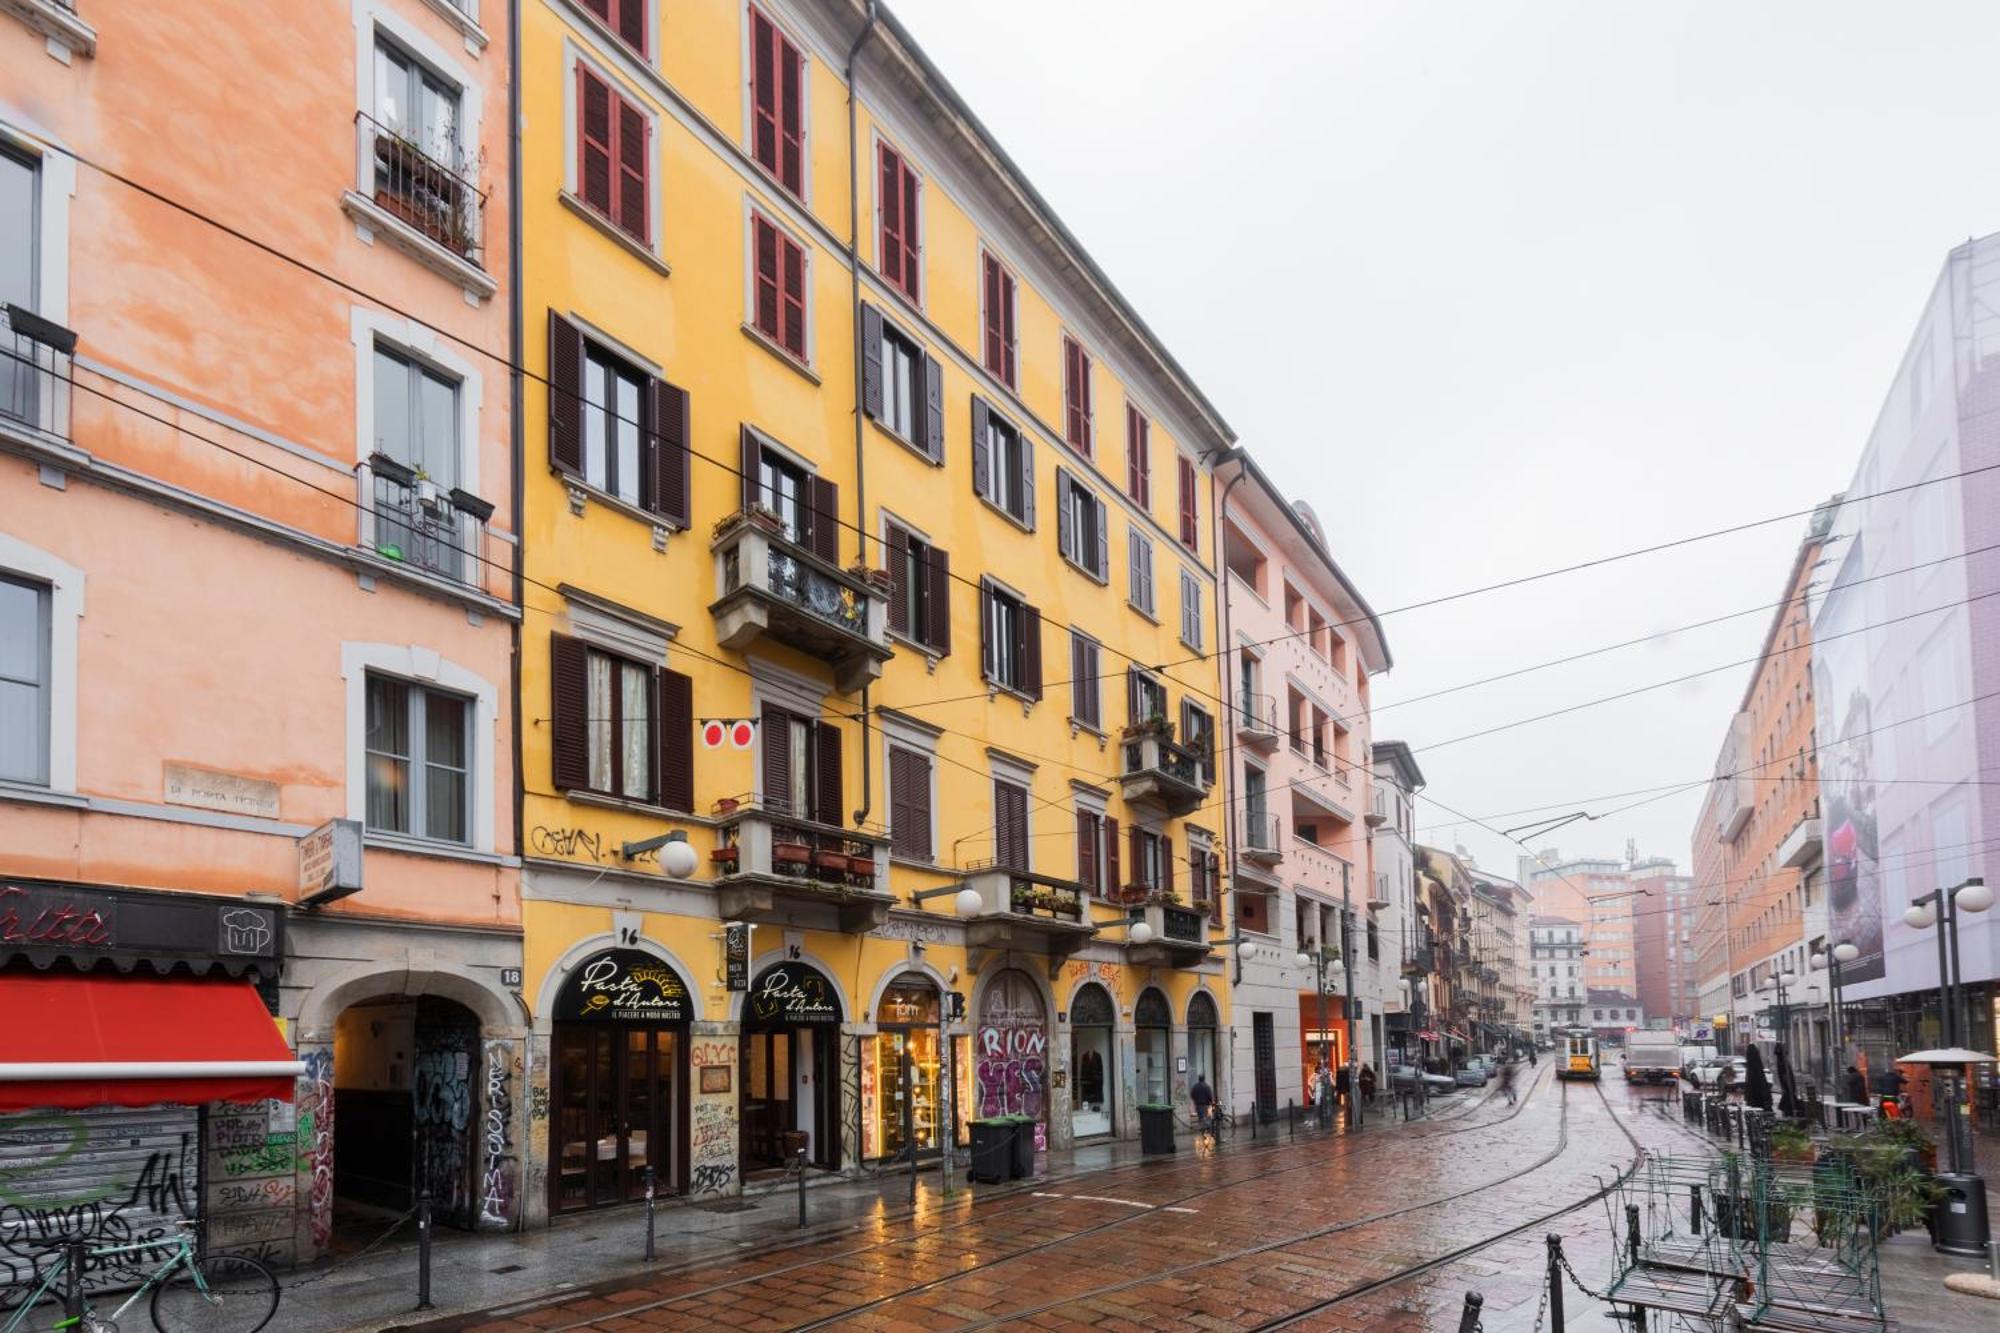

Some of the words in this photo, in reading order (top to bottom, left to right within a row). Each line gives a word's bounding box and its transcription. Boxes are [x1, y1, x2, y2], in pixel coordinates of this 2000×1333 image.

[621, 927, 639, 946] 16
[789, 945, 801, 959] 16
[504, 970, 520, 984] 18
[581, 956, 643, 992] Pasta
[763, 968, 808, 999] Pasta
[613, 992, 681, 1010] d'Autore
[786, 999, 834, 1014] d'Autore
[983, 1027, 1046, 1057] RION
